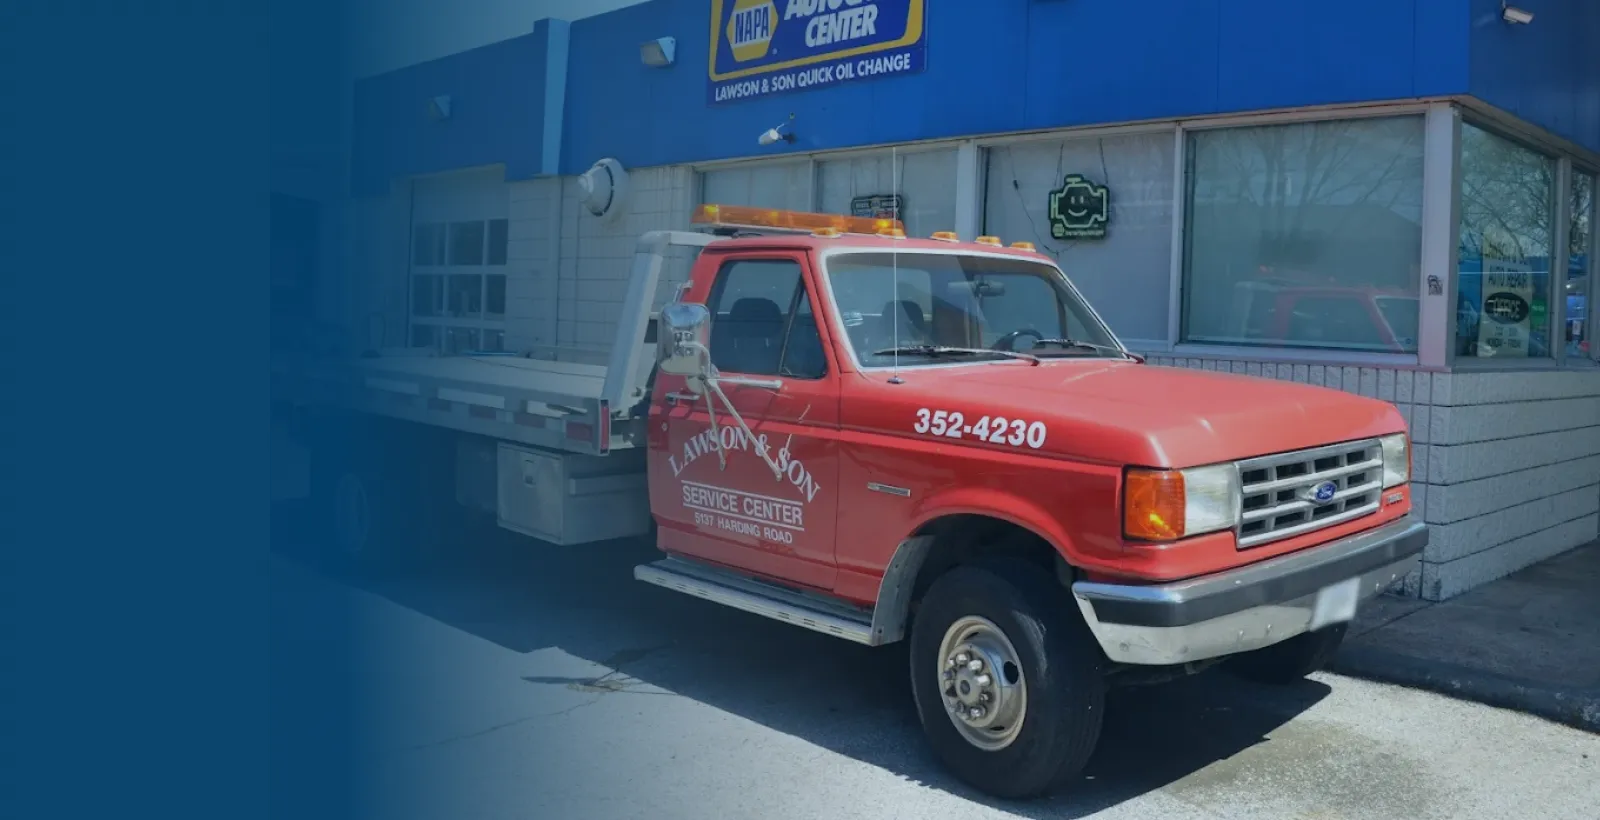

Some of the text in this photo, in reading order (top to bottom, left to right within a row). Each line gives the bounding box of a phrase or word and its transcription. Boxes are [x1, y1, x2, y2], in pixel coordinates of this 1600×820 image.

[735, 12, 769, 44] NAPA
[805, 4, 878, 48] CENTER
[715, 53, 911, 101] LAWSON & SON QUICK OIL CHANGE
[914, 408, 1046, 449] 352-4230
[668, 425, 751, 477] LAWSON
[776, 447, 821, 503] SON
[682, 485, 803, 525] SERVICE CENTER
[694, 512, 793, 544] 5137 HARDING ROAD
